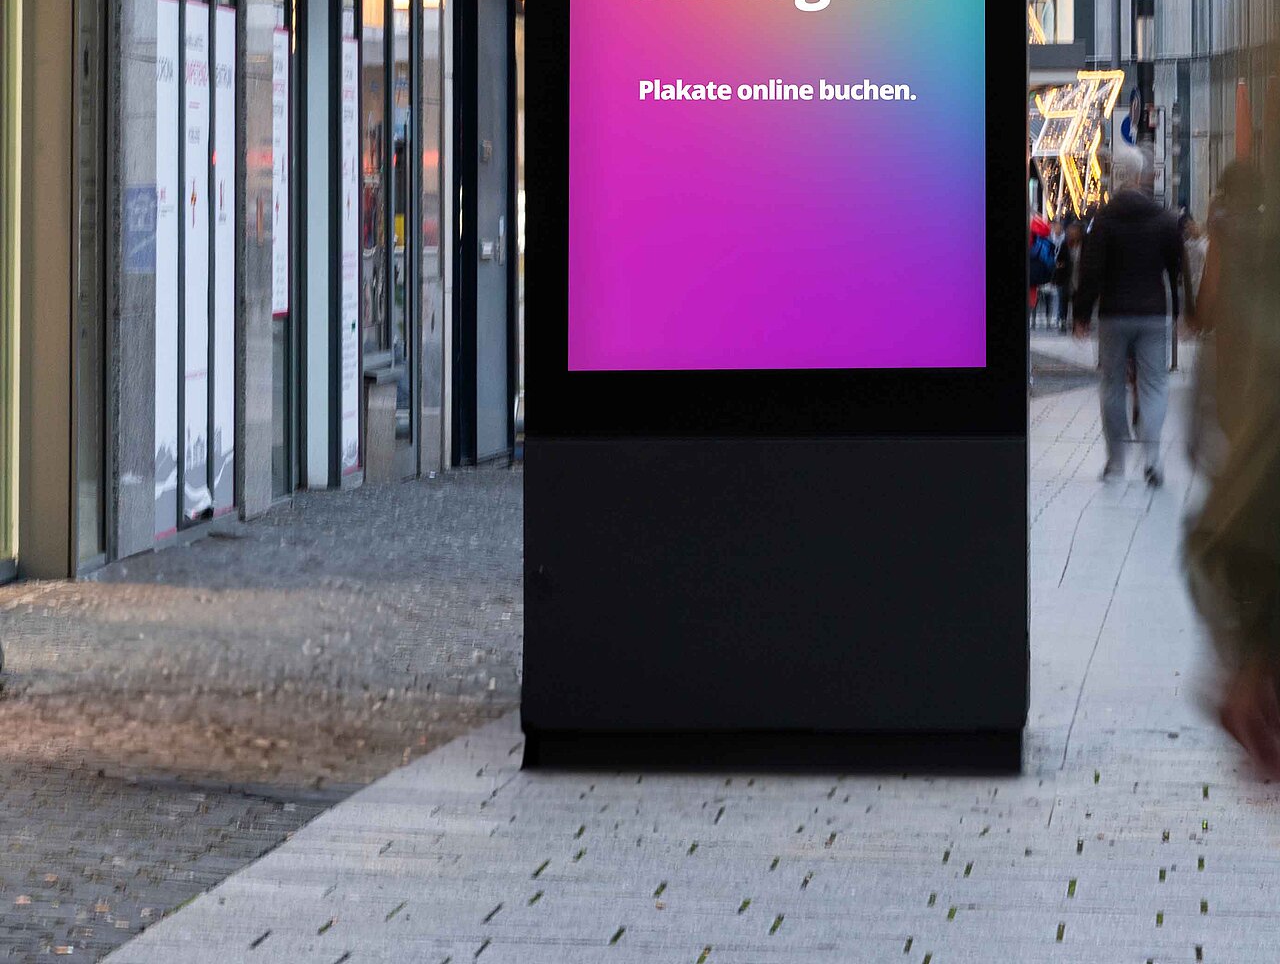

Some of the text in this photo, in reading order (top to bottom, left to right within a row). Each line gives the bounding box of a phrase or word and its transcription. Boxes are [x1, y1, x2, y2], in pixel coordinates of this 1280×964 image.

[638, 79, 918, 102] Plakate online buchen.
